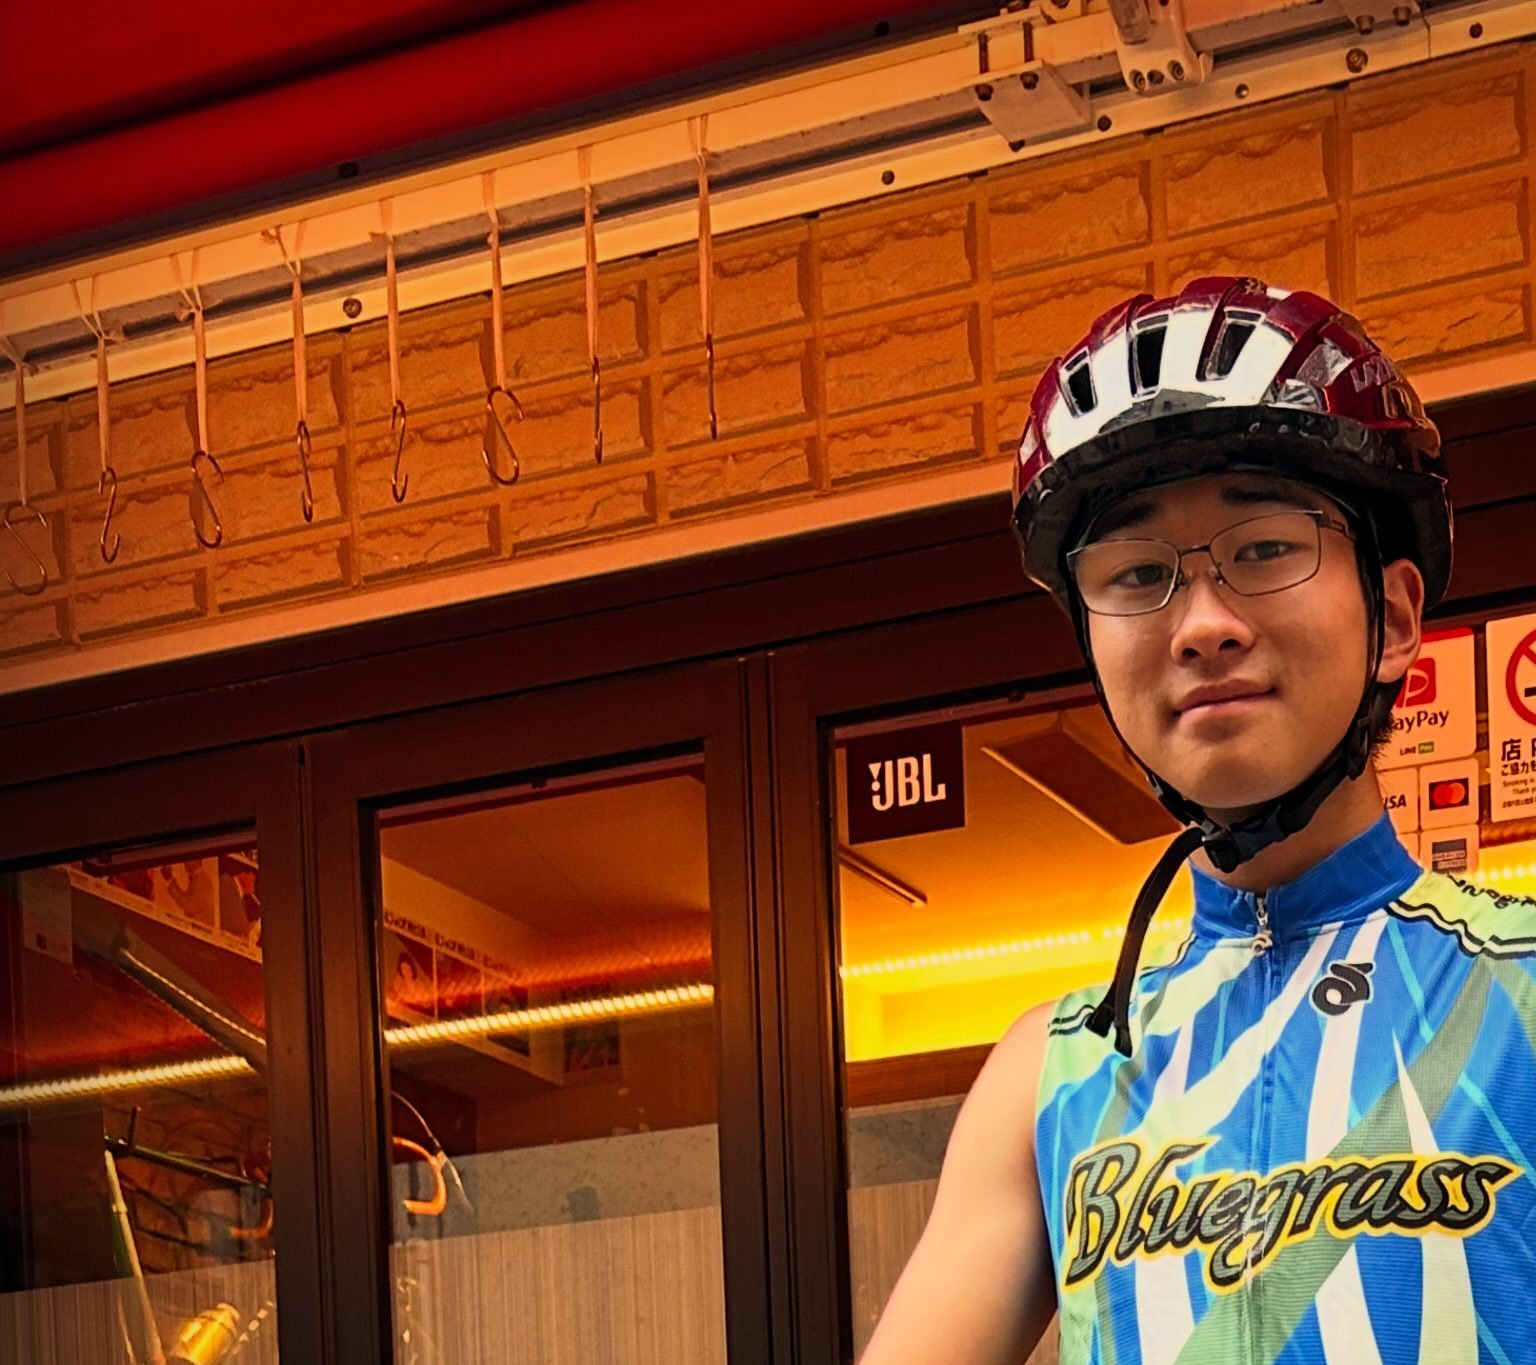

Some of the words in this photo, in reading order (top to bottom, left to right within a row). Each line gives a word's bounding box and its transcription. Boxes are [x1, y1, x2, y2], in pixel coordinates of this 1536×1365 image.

[1393, 710, 1450, 733] ayPay
[1399, 745, 1417, 757] LINE
[867, 752, 947, 812] JBL
[1384, 794, 1407, 810] ISA
[1064, 1138, 1518, 1289] Bluegrass
